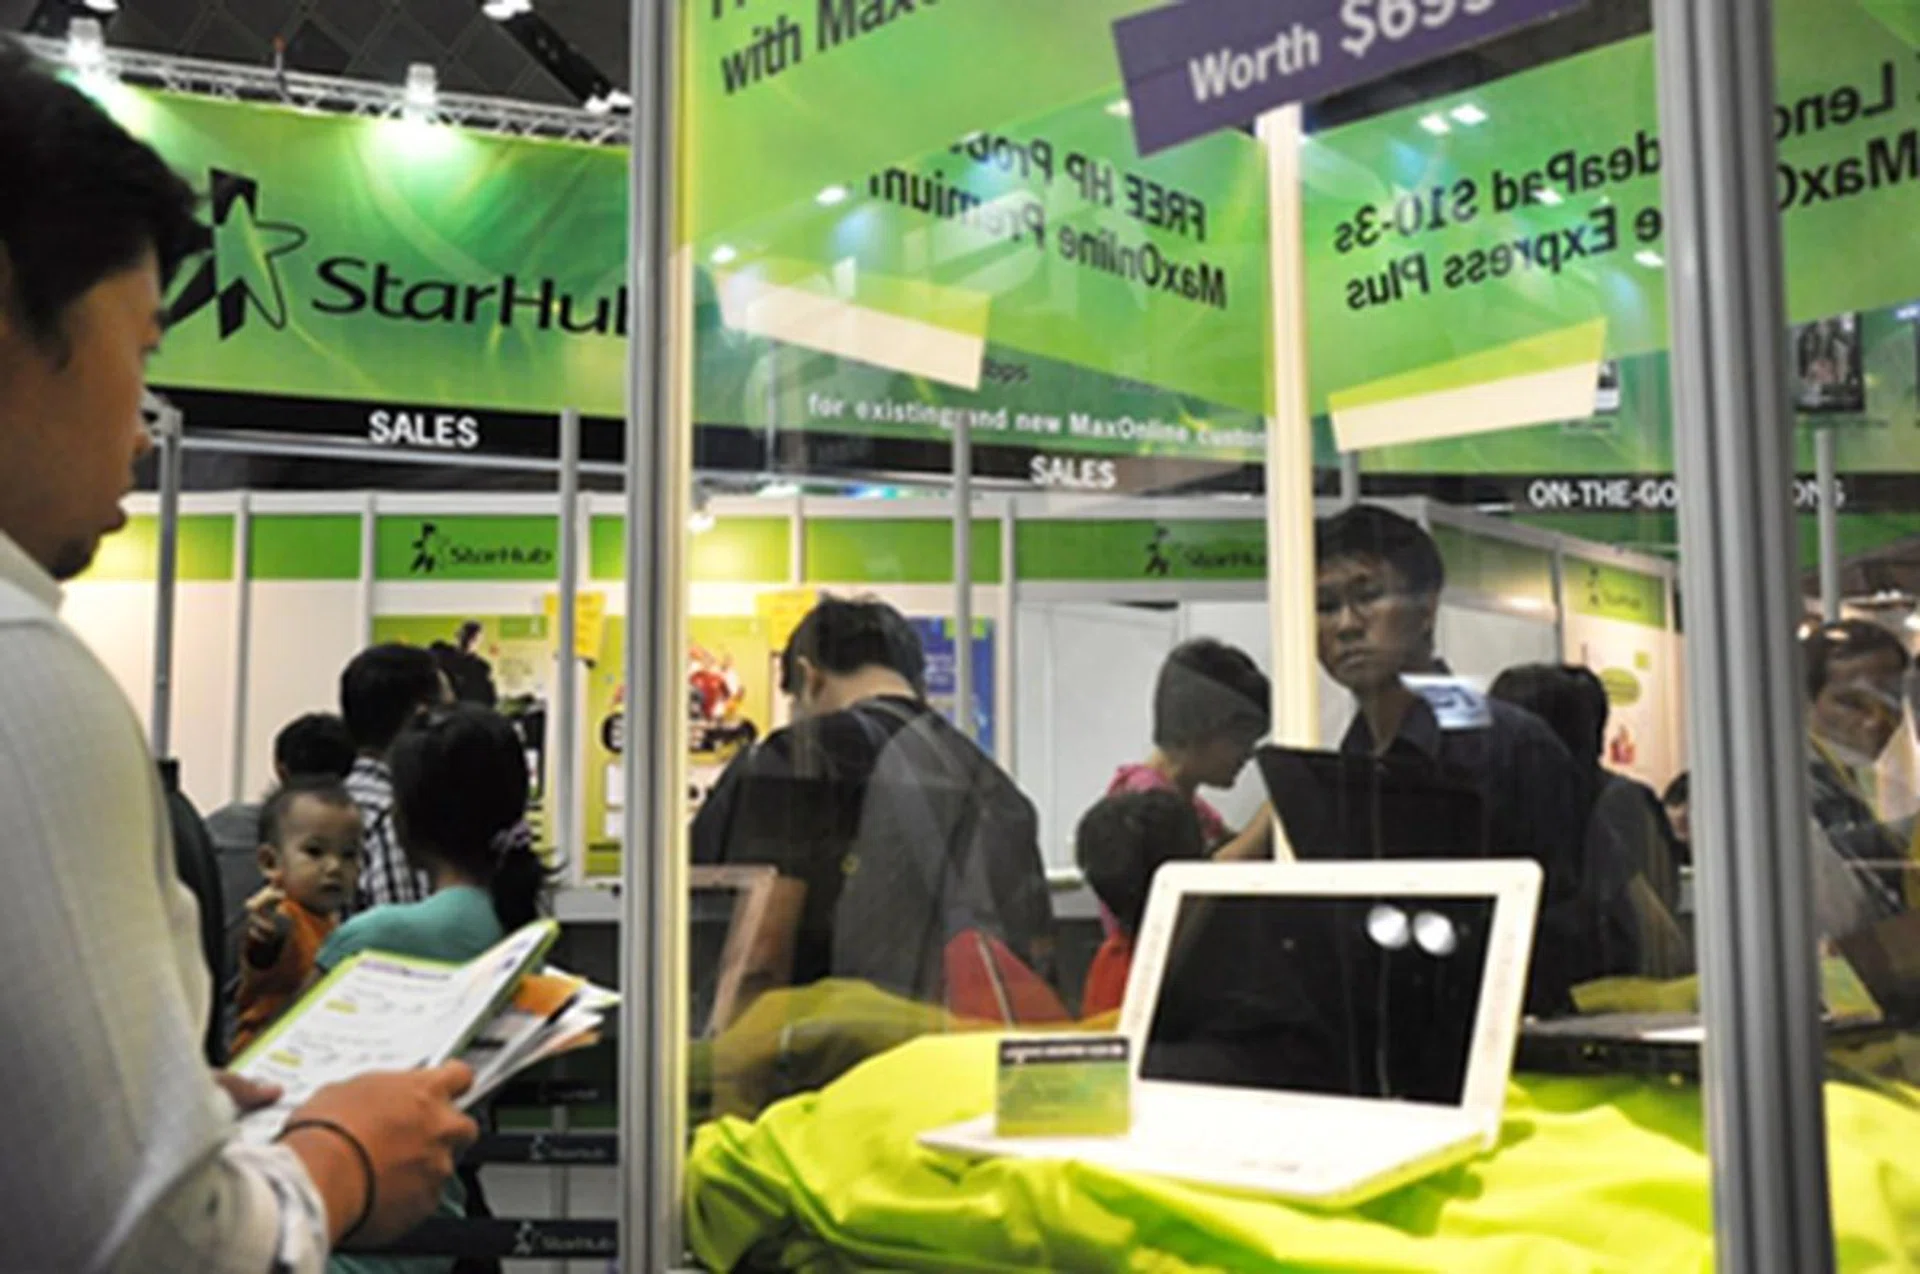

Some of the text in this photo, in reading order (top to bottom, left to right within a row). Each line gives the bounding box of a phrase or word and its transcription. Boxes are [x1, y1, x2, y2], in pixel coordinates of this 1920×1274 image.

[720, 0, 937, 95] with Max
[1188, 23, 1321, 103] Worth
[368, 410, 479, 447] SALES
[808, 393, 844, 417] for
[854, 398, 957, 430] existing
[1014, 412, 1061, 434] new
[1069, 411, 1188, 443] MaxOnline
[1030, 455, 1117, 489] SALES
